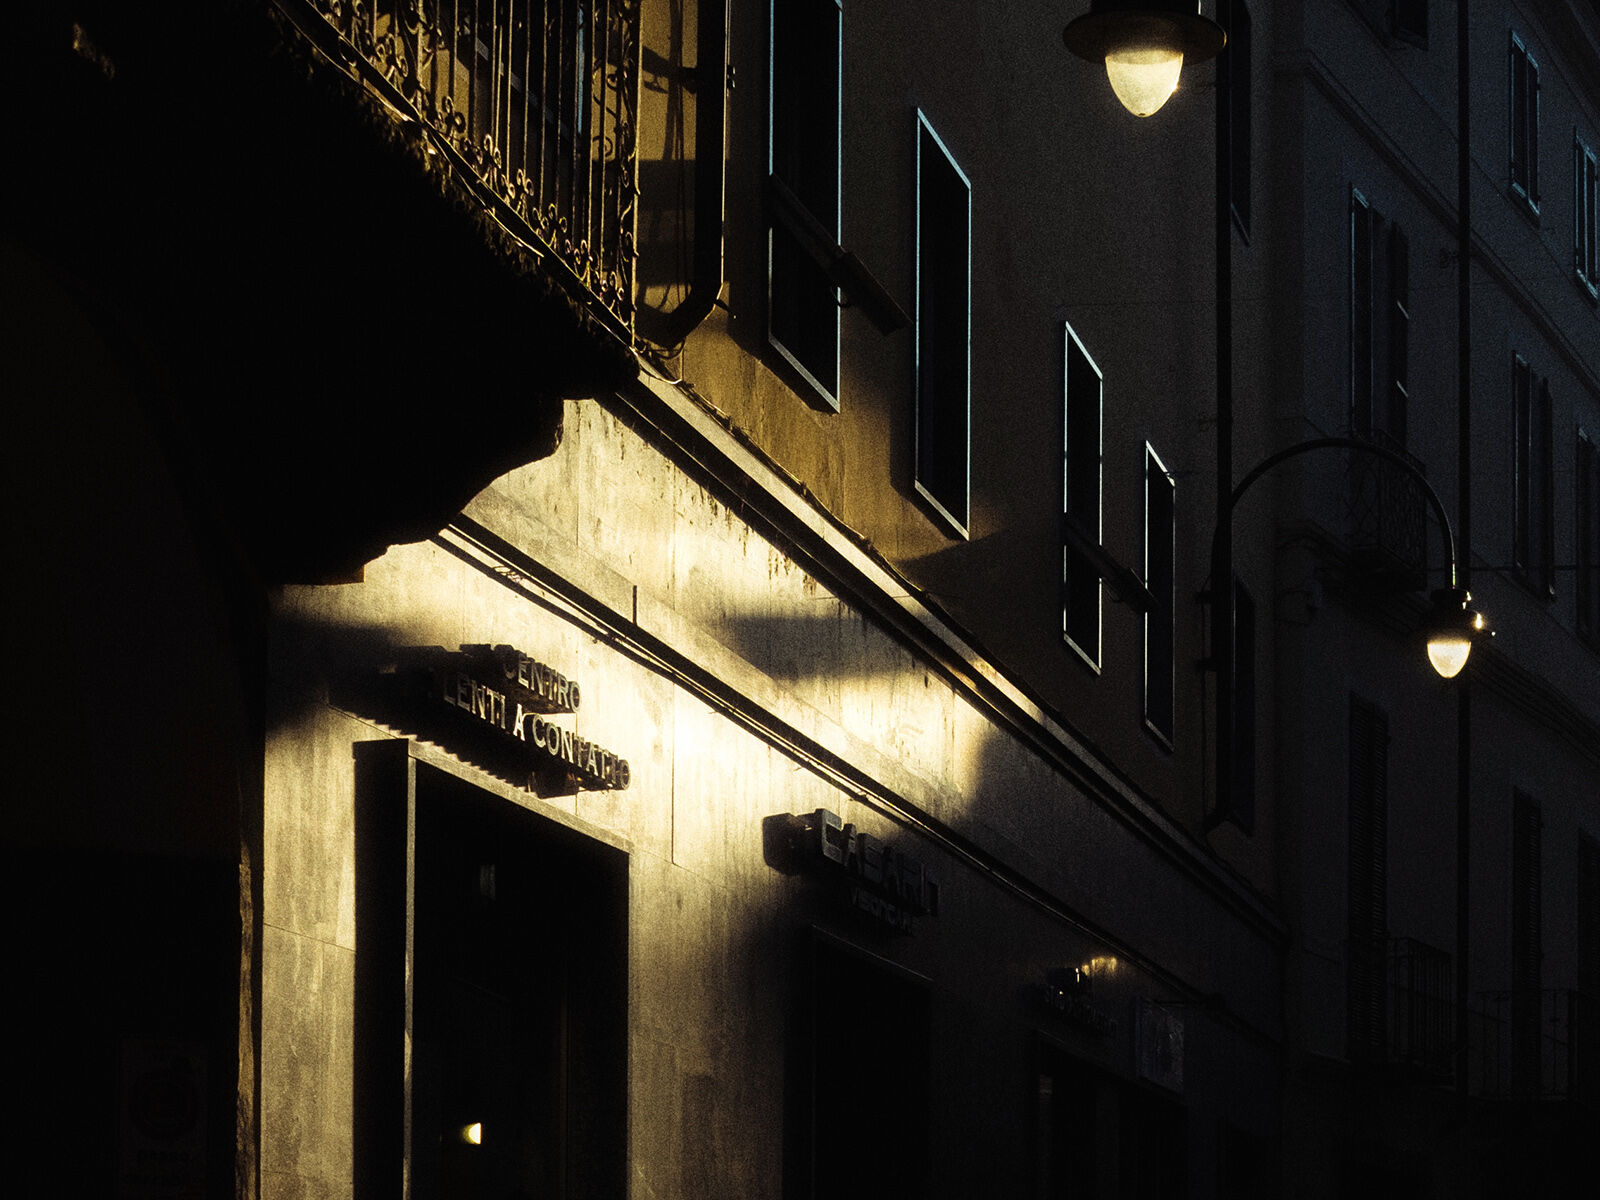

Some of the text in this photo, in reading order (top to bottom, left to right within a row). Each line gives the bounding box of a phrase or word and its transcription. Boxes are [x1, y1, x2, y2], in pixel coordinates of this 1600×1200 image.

[502, 652, 582, 713] CENTRO
[442, 672, 632, 791] LENTI A CONTATTO
